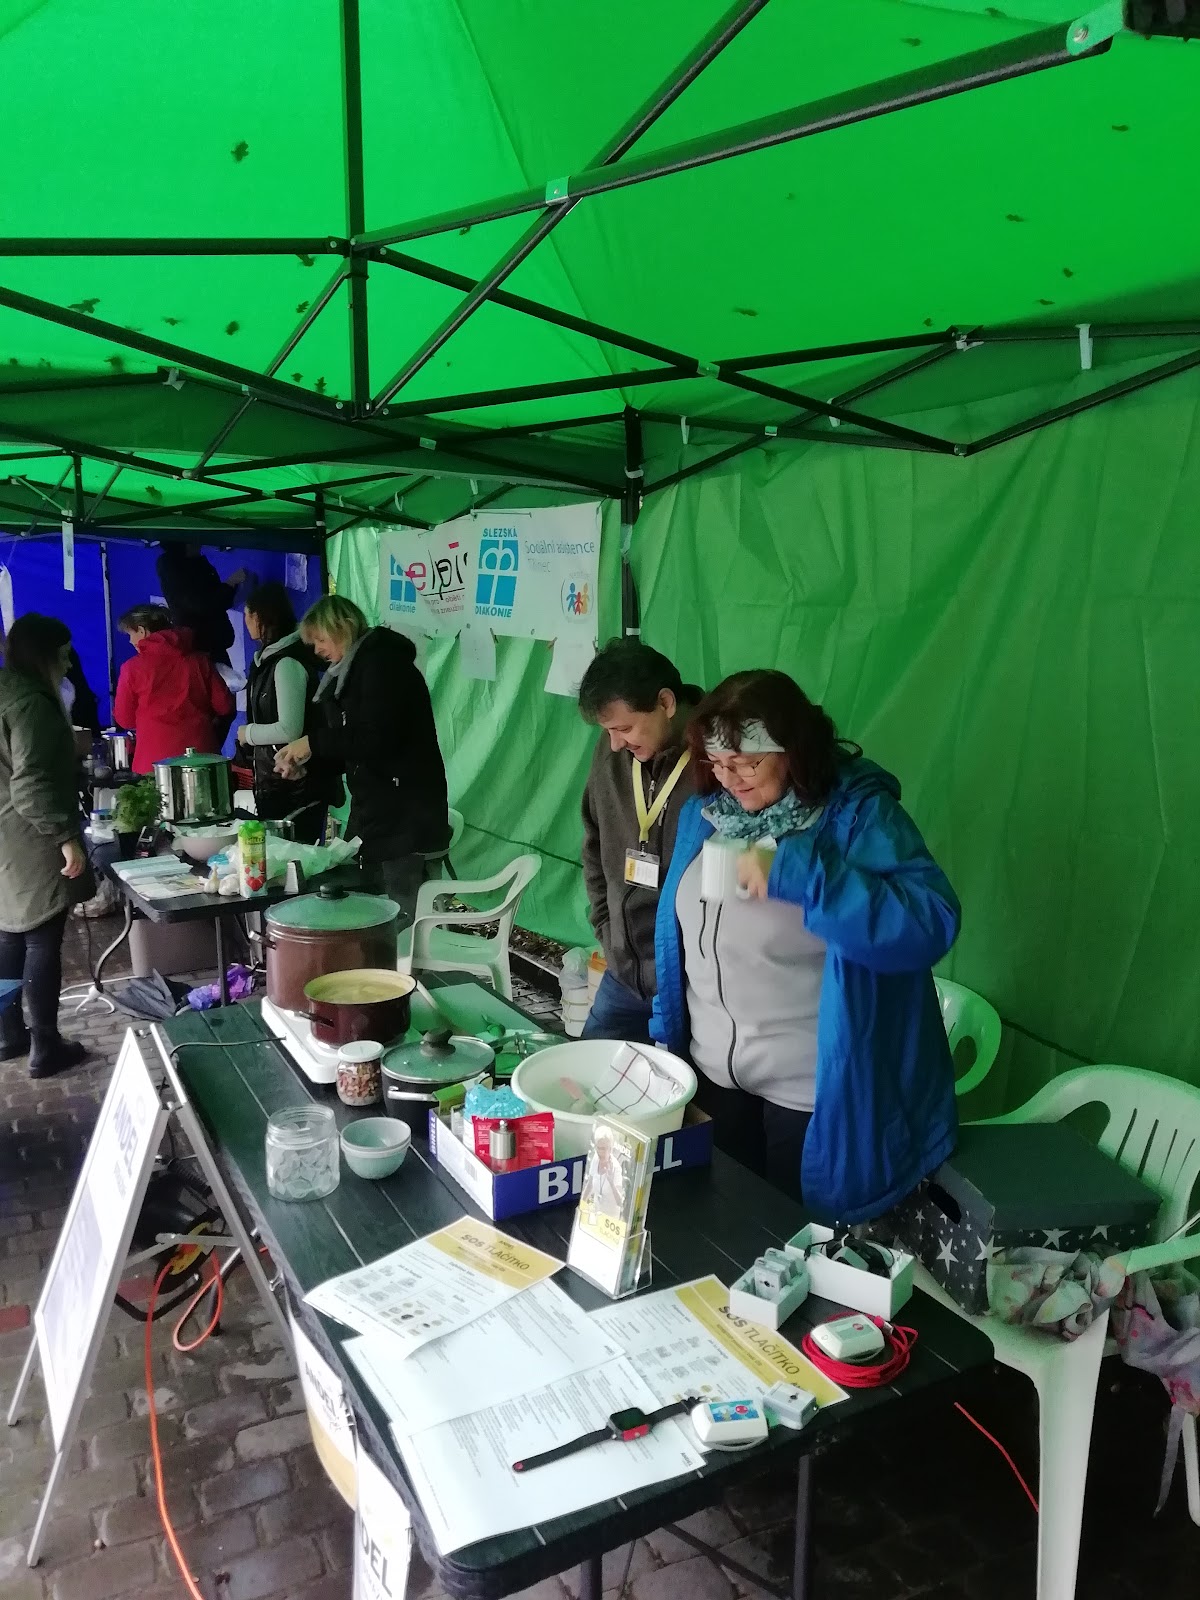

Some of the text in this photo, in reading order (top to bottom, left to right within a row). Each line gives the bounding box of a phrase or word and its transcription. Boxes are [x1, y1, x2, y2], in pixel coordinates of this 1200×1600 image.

[482, 526, 518, 538] SLEZSKÁ
[389, 603, 416, 614] diakonie
[475, 605, 512, 618] DIAKONIE
[604, 1218, 621, 1236] SOS
[460, 1232, 485, 1250] SOS
[484, 1243, 530, 1272] TLAČÍTKO
[744, 1326, 801, 1376] TLAČÍTKO
